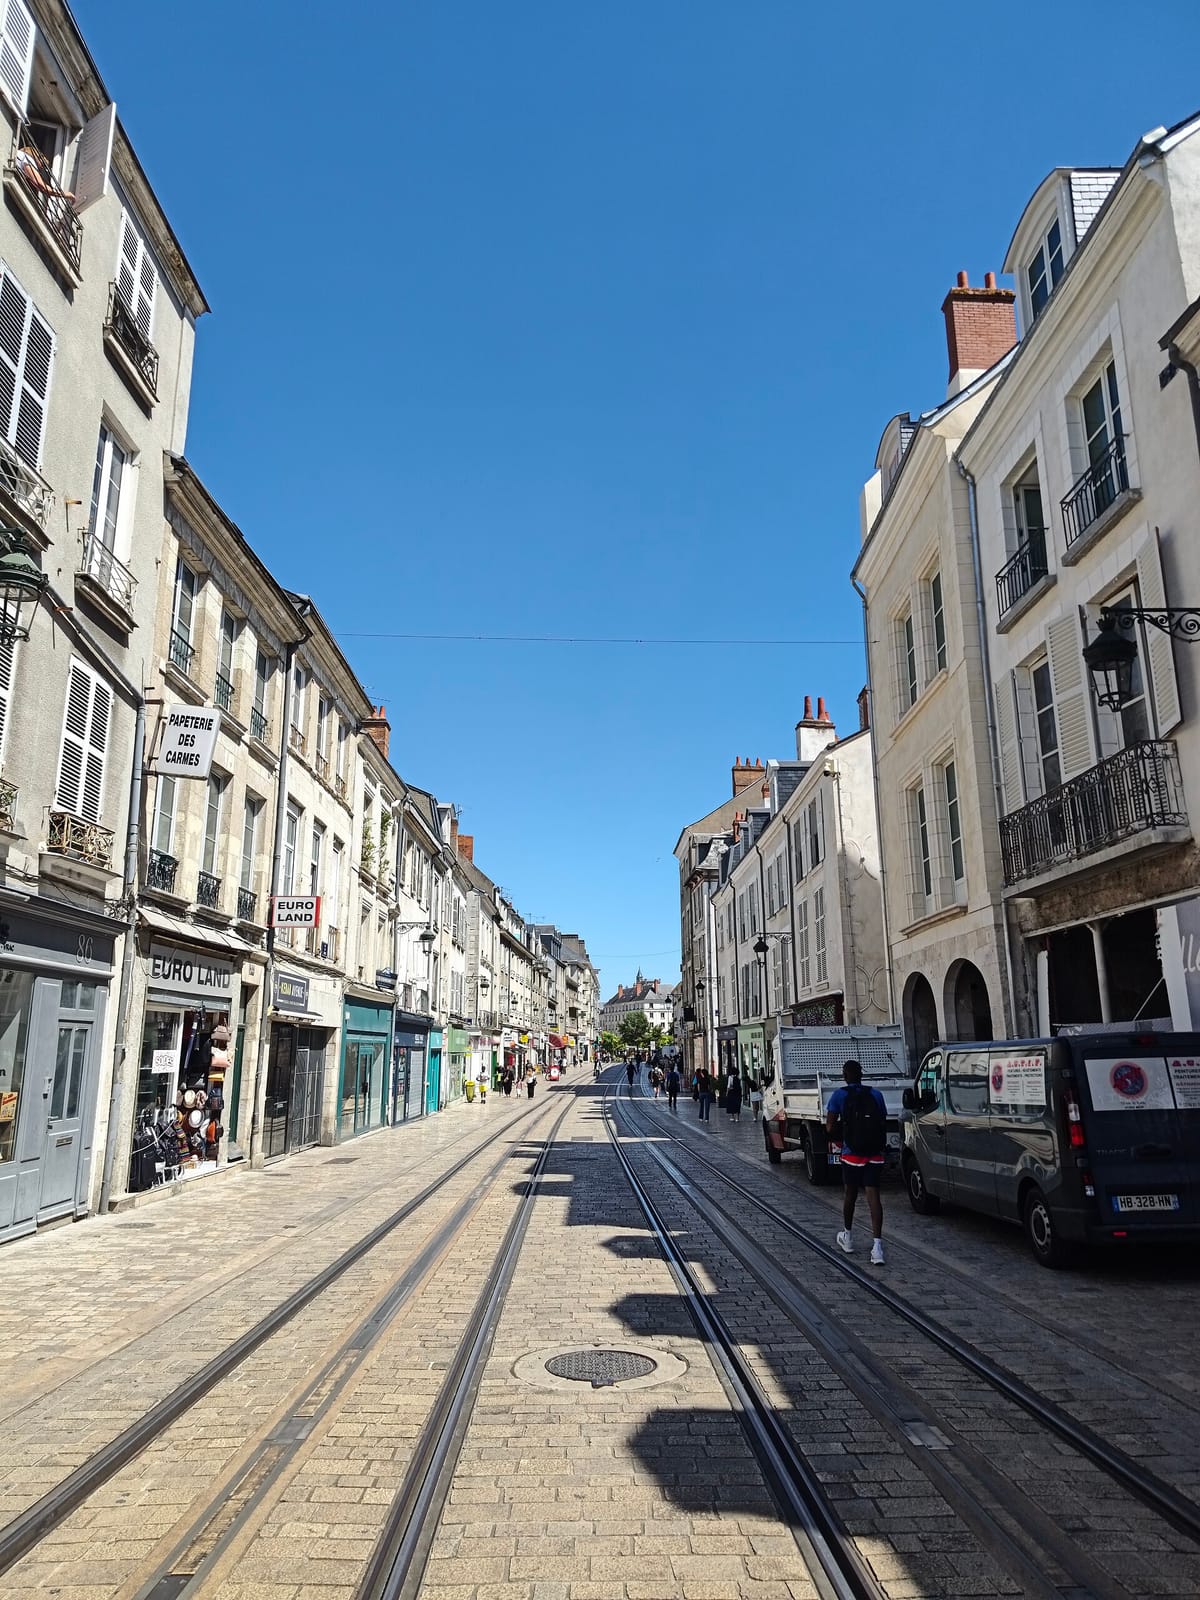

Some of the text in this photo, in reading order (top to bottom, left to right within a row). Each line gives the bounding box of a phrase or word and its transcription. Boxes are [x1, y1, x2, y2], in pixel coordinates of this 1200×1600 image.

[168, 713, 214, 731] PAPETERIE
[178, 733, 196, 747] DES
[165, 750, 201, 766] CARMES
[277, 901, 314, 910] EURO
[277, 913, 313, 922] LAND
[76, 934, 94, 964] 86
[152, 954, 193, 983] EURO
[197, 963, 231, 989] LAND
[1119, 1196, 1172, 1209] HB-328-HN
